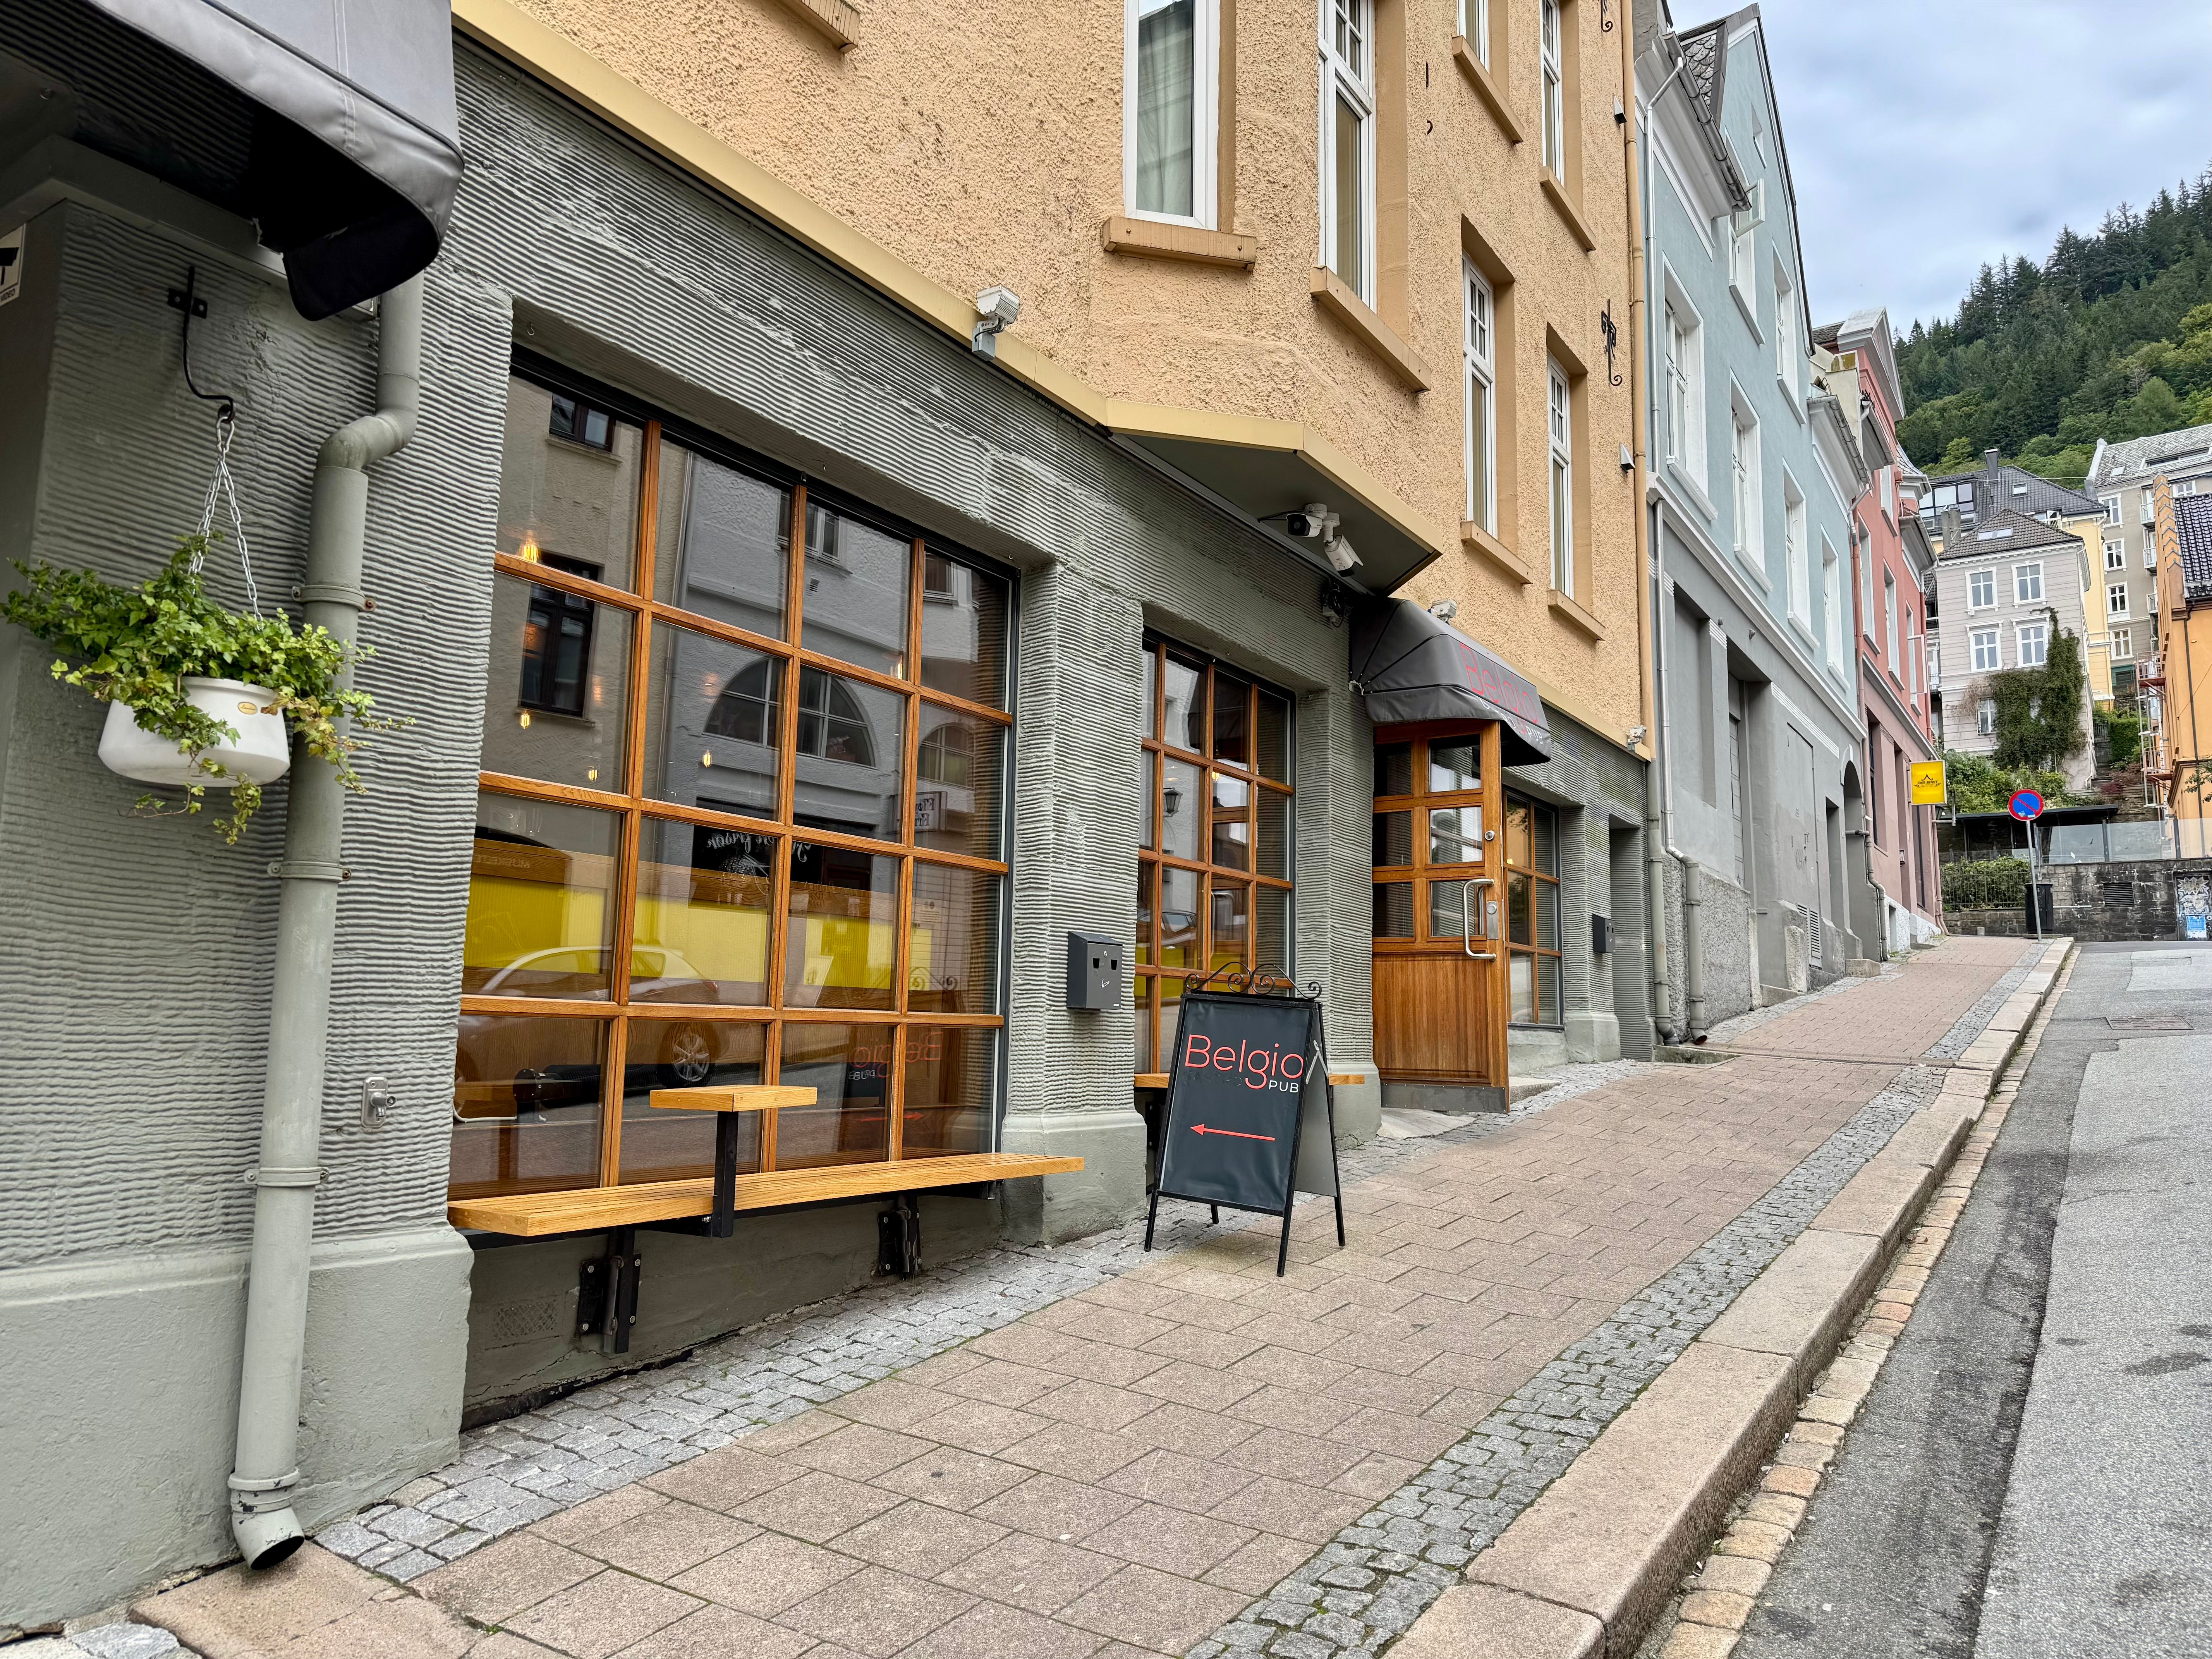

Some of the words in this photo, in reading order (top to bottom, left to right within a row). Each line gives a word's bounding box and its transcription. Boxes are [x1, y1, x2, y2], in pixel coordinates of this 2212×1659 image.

[1459, 642, 1538, 735] Belgio
[1526, 726, 1543, 744] PUB
[1185, 1034, 1304, 1089] Belgio
[1269, 1080, 1299, 1093] PUB
